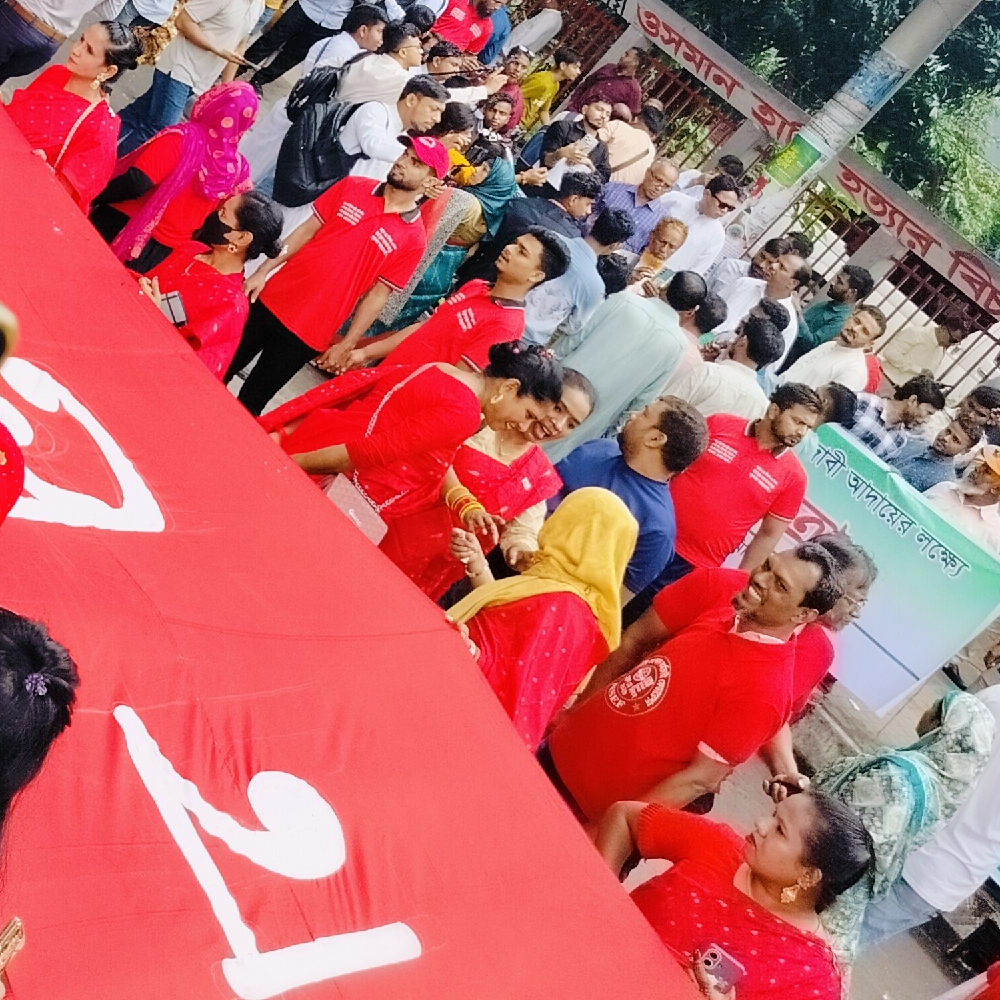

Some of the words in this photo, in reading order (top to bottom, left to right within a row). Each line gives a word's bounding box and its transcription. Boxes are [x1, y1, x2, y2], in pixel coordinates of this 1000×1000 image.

[637, 2, 745, 100] ওসমান
[836, 161, 942, 257] হত্যার
[848, 470, 917, 536] আদায়ের
[915, 527, 970, 577] লক্ষ্যে
